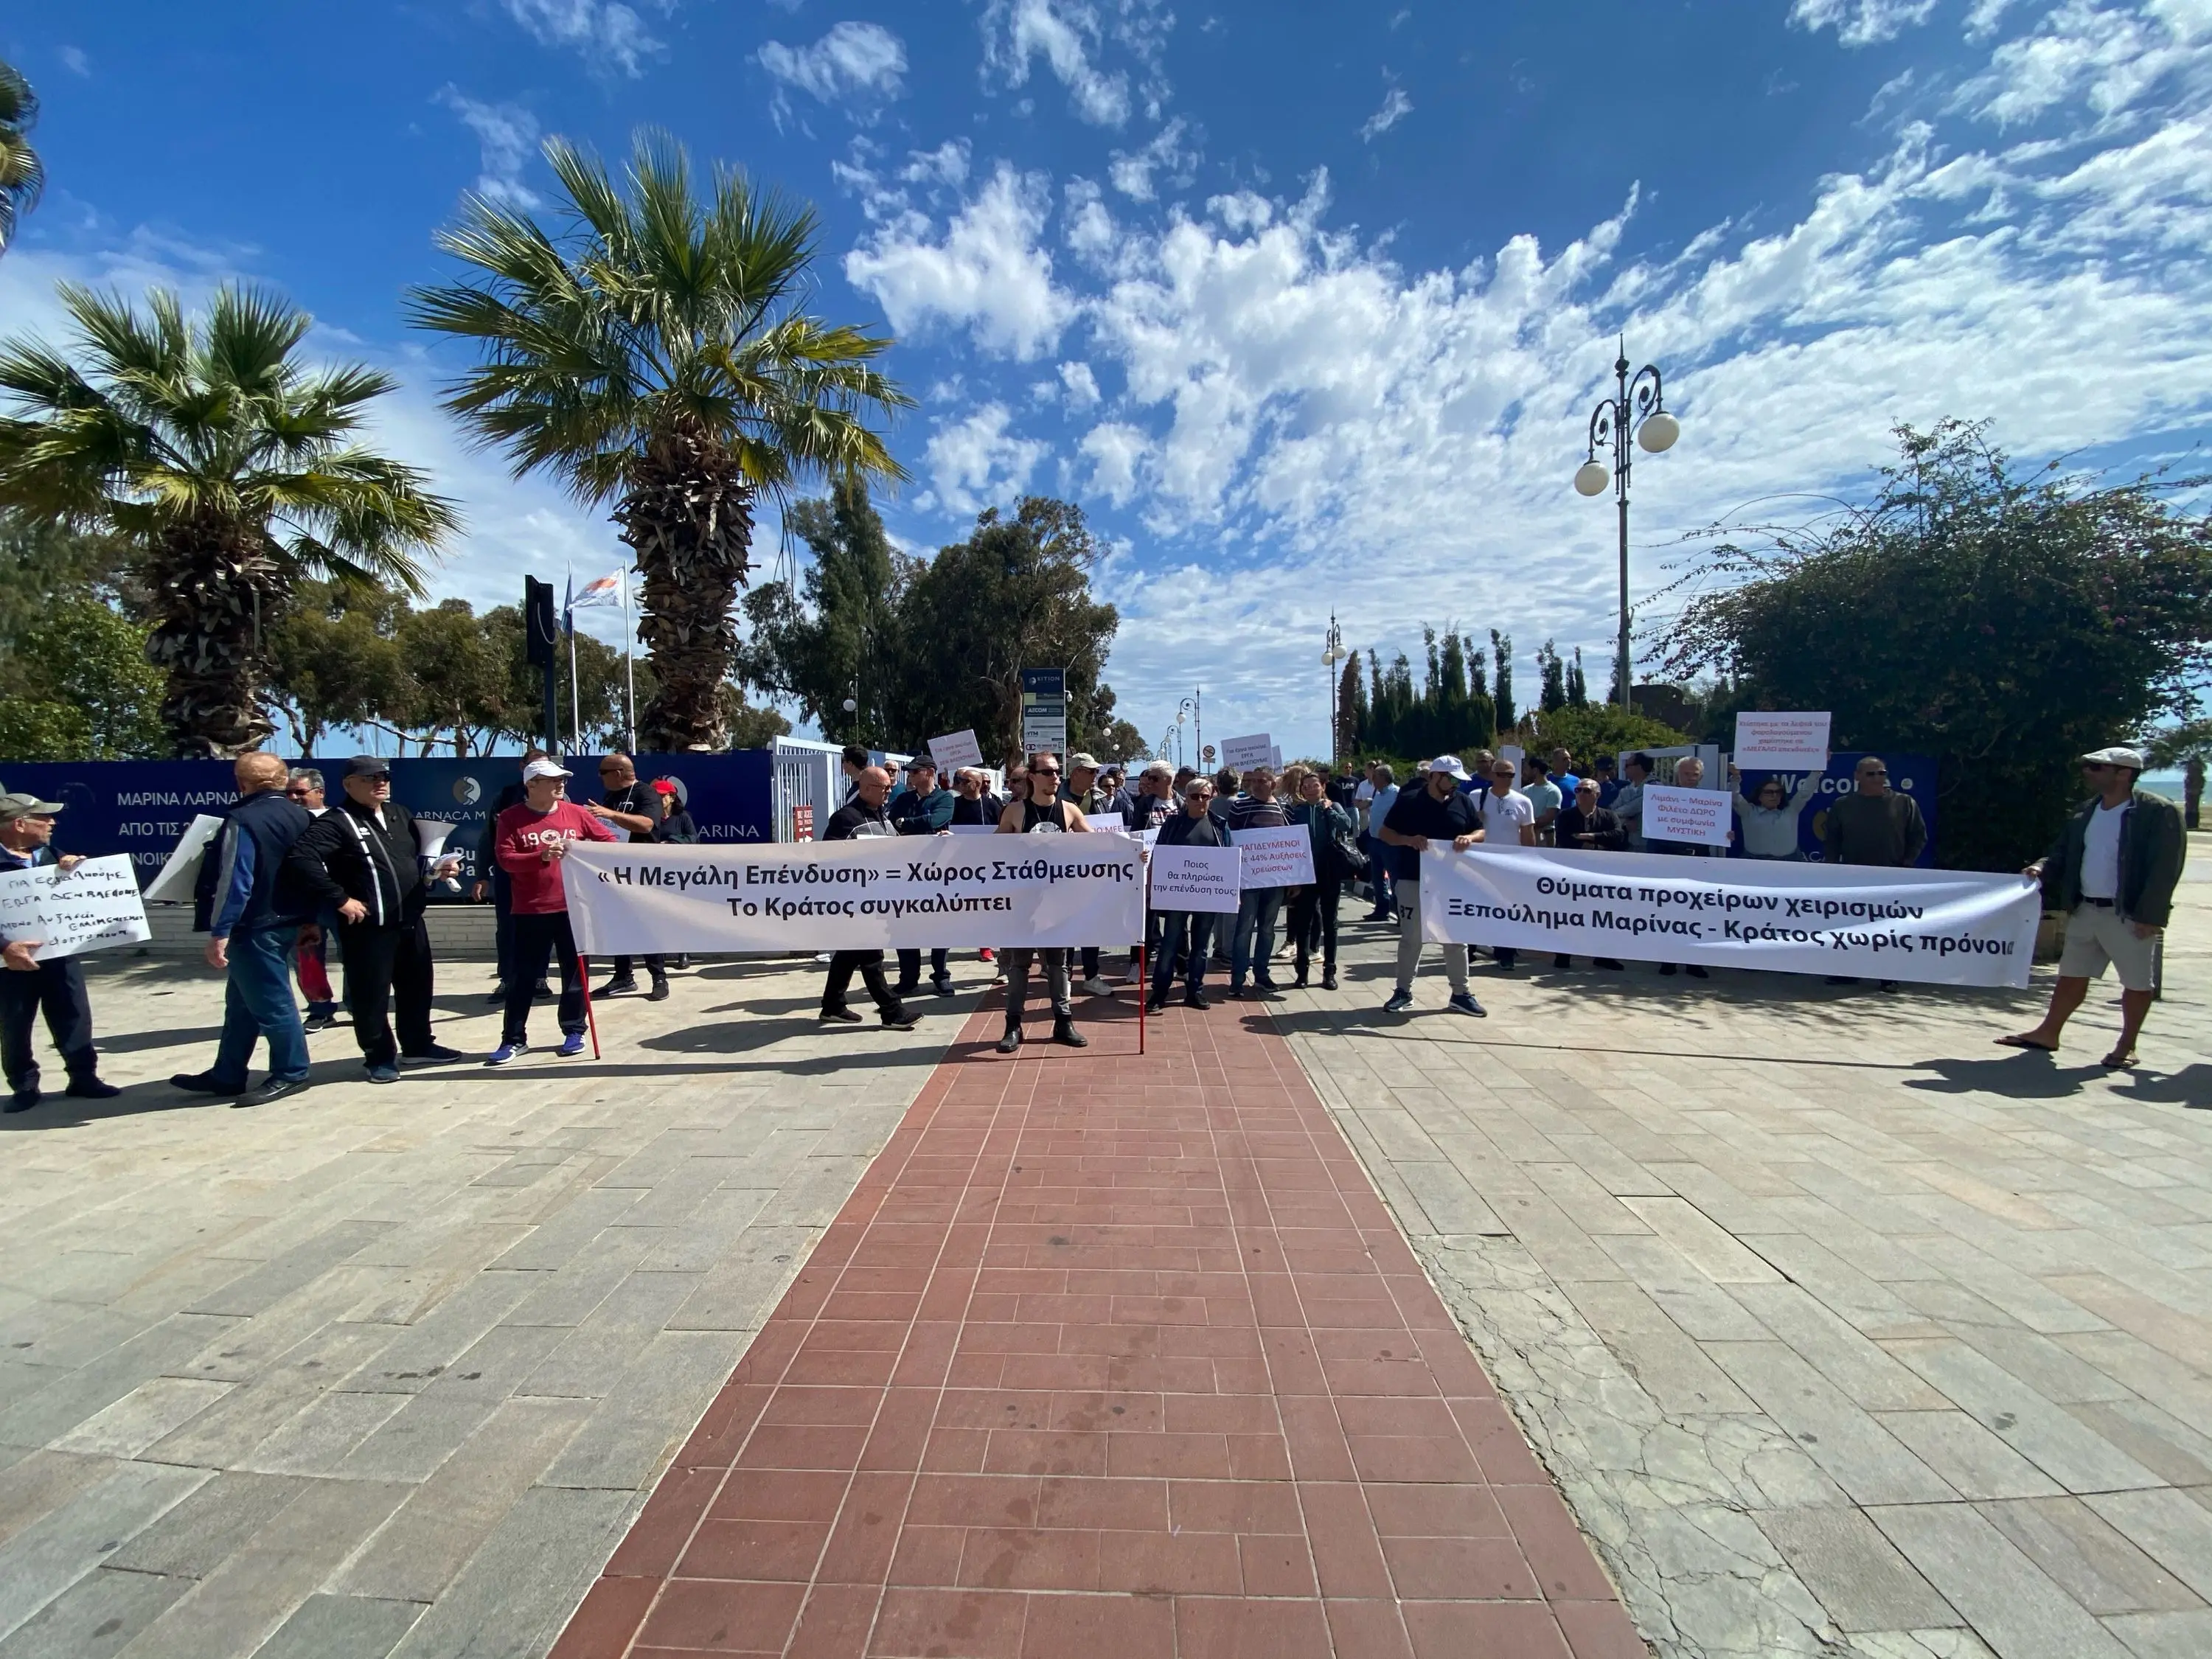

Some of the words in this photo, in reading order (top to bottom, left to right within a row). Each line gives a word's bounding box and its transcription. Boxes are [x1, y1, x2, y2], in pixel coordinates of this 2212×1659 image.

[117, 792, 180, 806] ΜΑΡΙΝΑ
[1651, 793, 1680, 803] Λιμάνι
[1688, 797, 1722, 807] Μαρίνα
[416, 812, 471, 821] ARNACA
[1690, 808, 1716, 816] ΔΩΡΟ
[1670, 817, 1716, 827] συμφωνία
[118, 823, 153, 836] ΑΠΟ
[156, 823, 179, 835] ΤΙΣ
[699, 824, 759, 838] ARINA
[1667, 826, 1705, 836] ΜΥΣΤΙΚΗ
[131, 852, 173, 866] ΝΟΙΚ
[1269, 852, 1307, 861] Αυξήσεις
[1184, 860, 1208, 869] Ποιος
[1251, 864, 1293, 875] χρεώσεων
[614, 866, 632, 885] Η
[639, 864, 738, 891] Μεγάλη
[746, 863, 880, 888] Επένδυση»
[886, 869, 901, 880] =
[907, 861, 986, 886] Χώρος
[992, 859, 1133, 884] Στάθμευσης
[1167, 871, 1180, 880] θα
[1181, 872, 1224, 883] πληρώσει
[1153, 884, 1167, 892] την
[1169, 883, 1212, 895] επένδυση
[1214, 888, 1237, 897] τους;
[1536, 876, 1632, 902] Θύματα
[1638, 886, 1778, 912] προχείρων
[1784, 897, 1923, 922] χειρισμών
[726, 897, 757, 917] Το
[765, 896, 854, 921] Κράτος
[860, 893, 1012, 918] συγκαλύπτει
[1448, 897, 1585, 929] Ξεπούλημα
[1592, 910, 1701, 939] Μαρίνας
[1724, 919, 1825, 947] Κράτος
[1829, 929, 1913, 953] χωρίς
